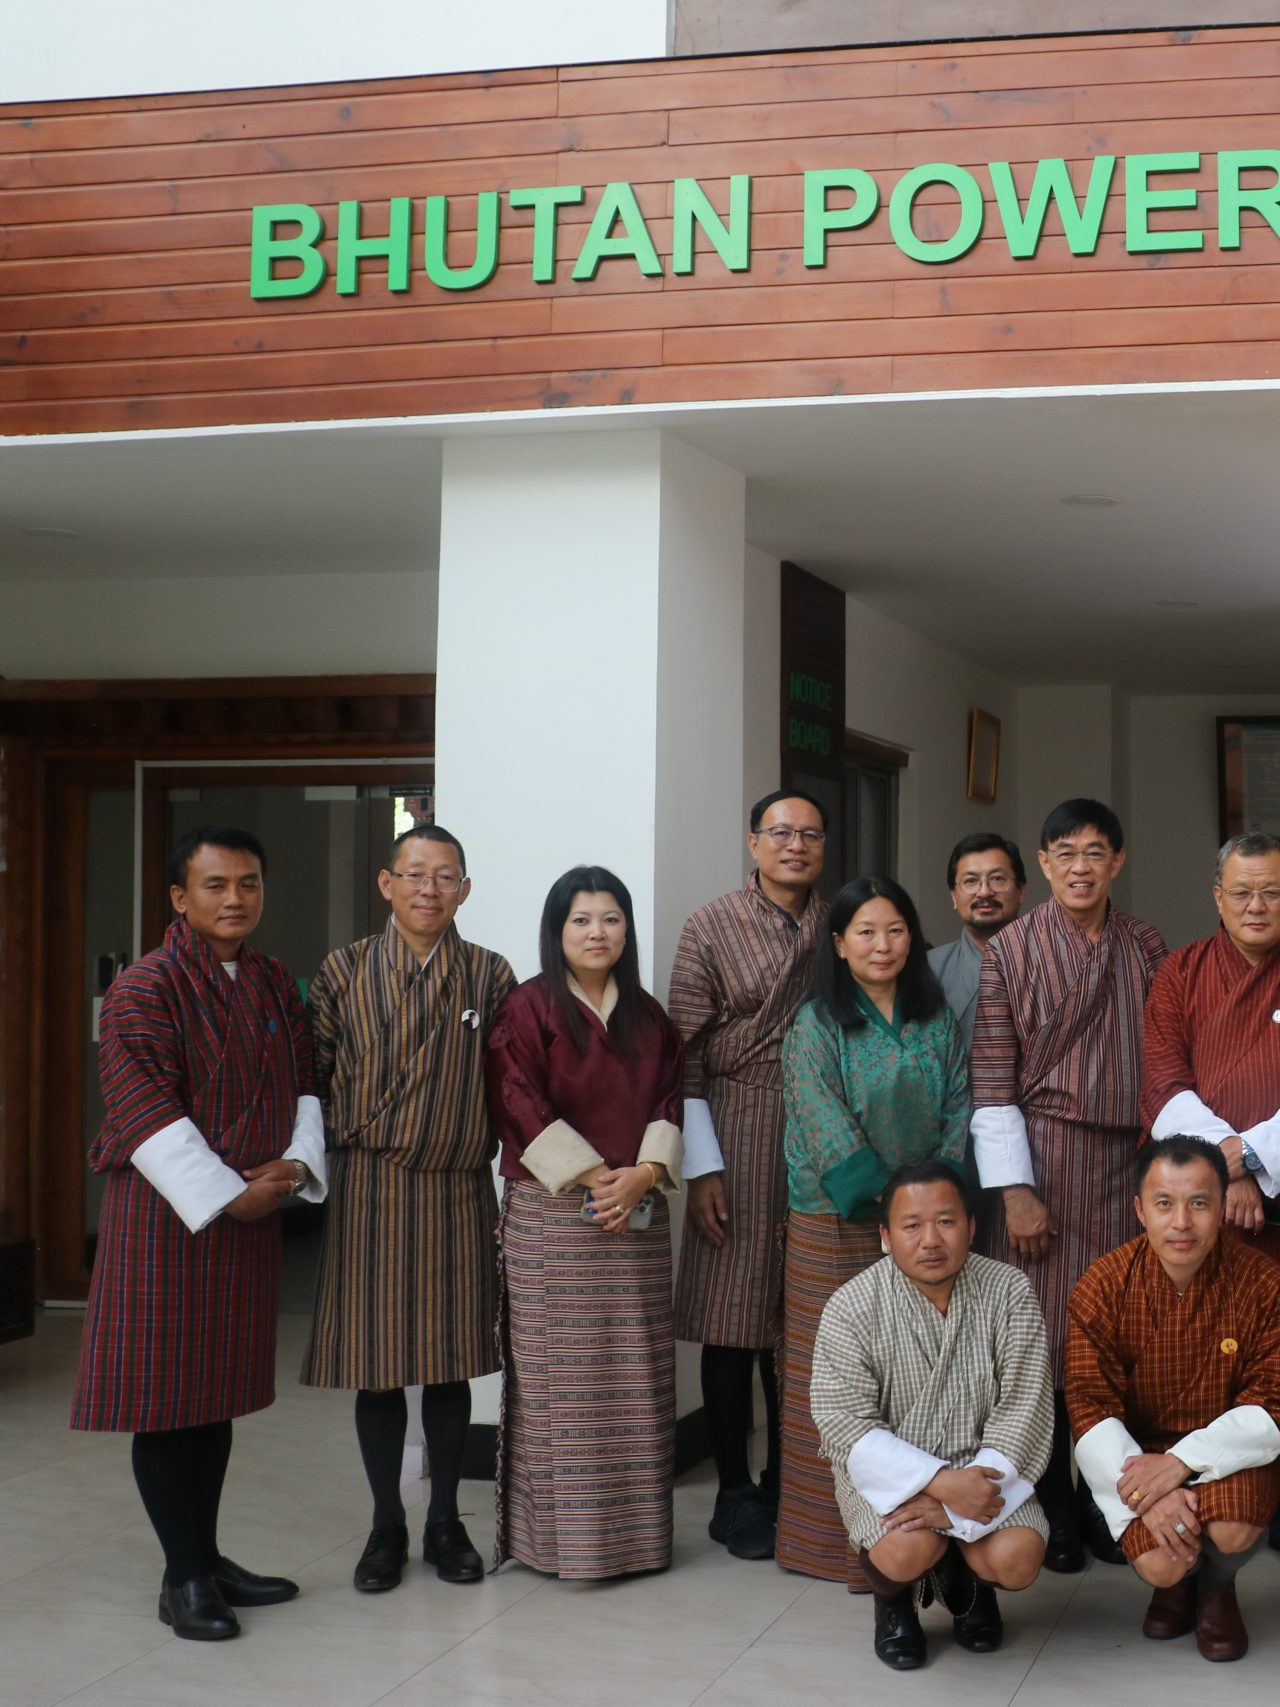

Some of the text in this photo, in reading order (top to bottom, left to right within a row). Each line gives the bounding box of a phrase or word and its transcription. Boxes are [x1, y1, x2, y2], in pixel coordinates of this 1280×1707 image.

[249, 173, 750, 300] BHUTAN
[788, 671, 833, 712] NOTICE
[788, 717, 831, 756] BOARD
